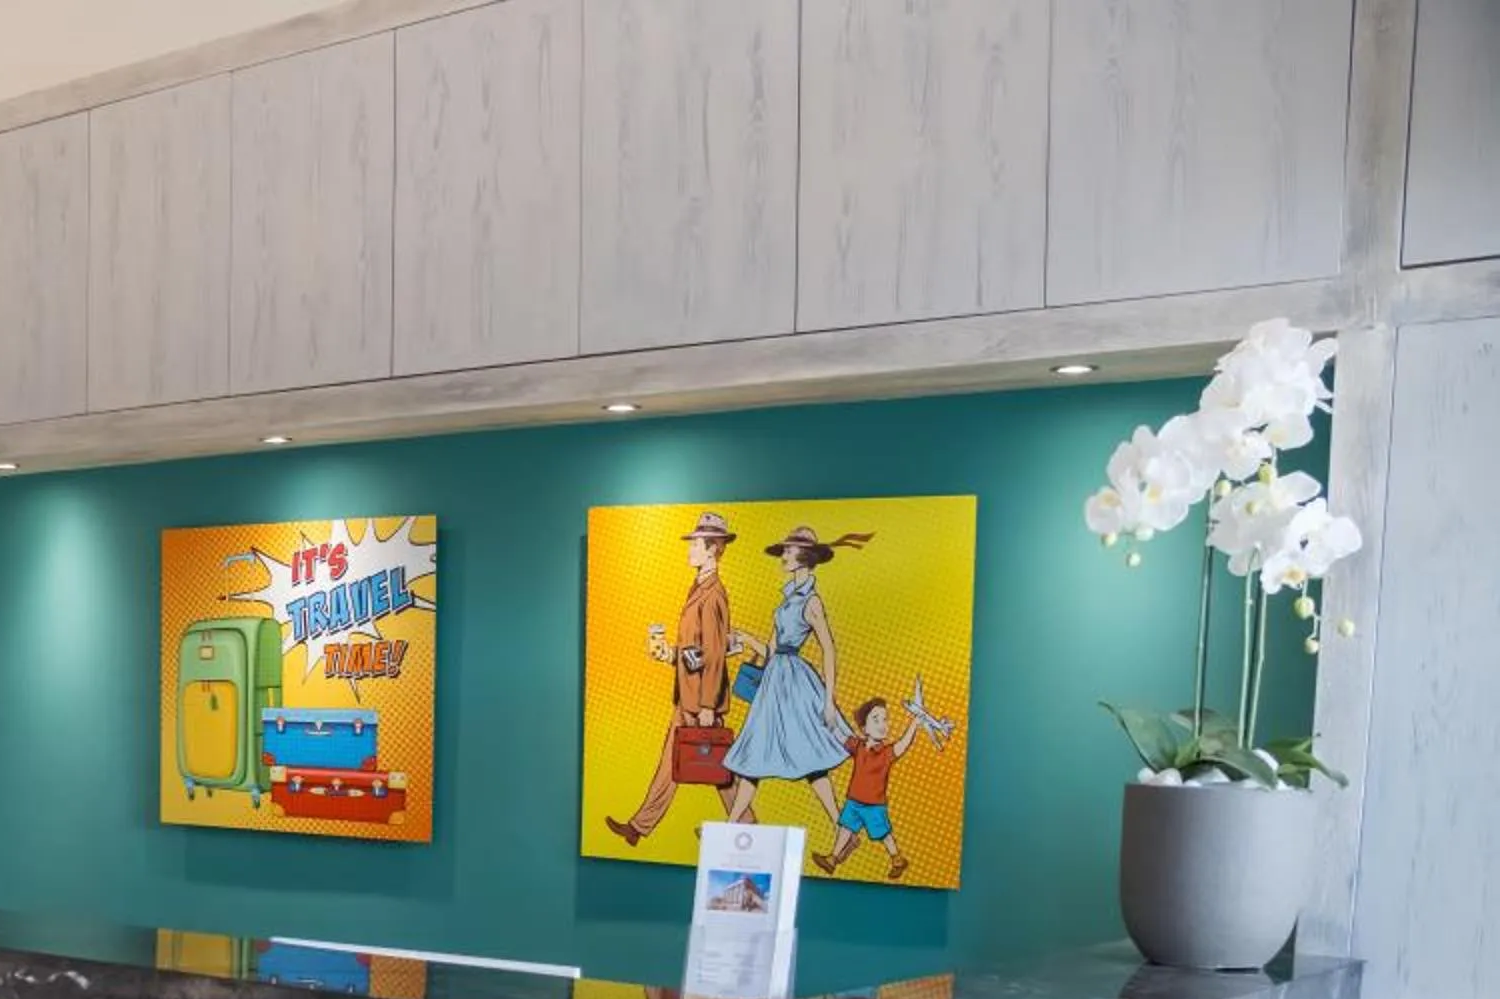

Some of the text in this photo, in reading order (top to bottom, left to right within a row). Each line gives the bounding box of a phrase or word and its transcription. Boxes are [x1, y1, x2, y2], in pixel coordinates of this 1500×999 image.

[292, 542, 348, 586] IT'S
[286, 565, 413, 642] TRAVEL
[323, 640, 408, 678] TIME!
